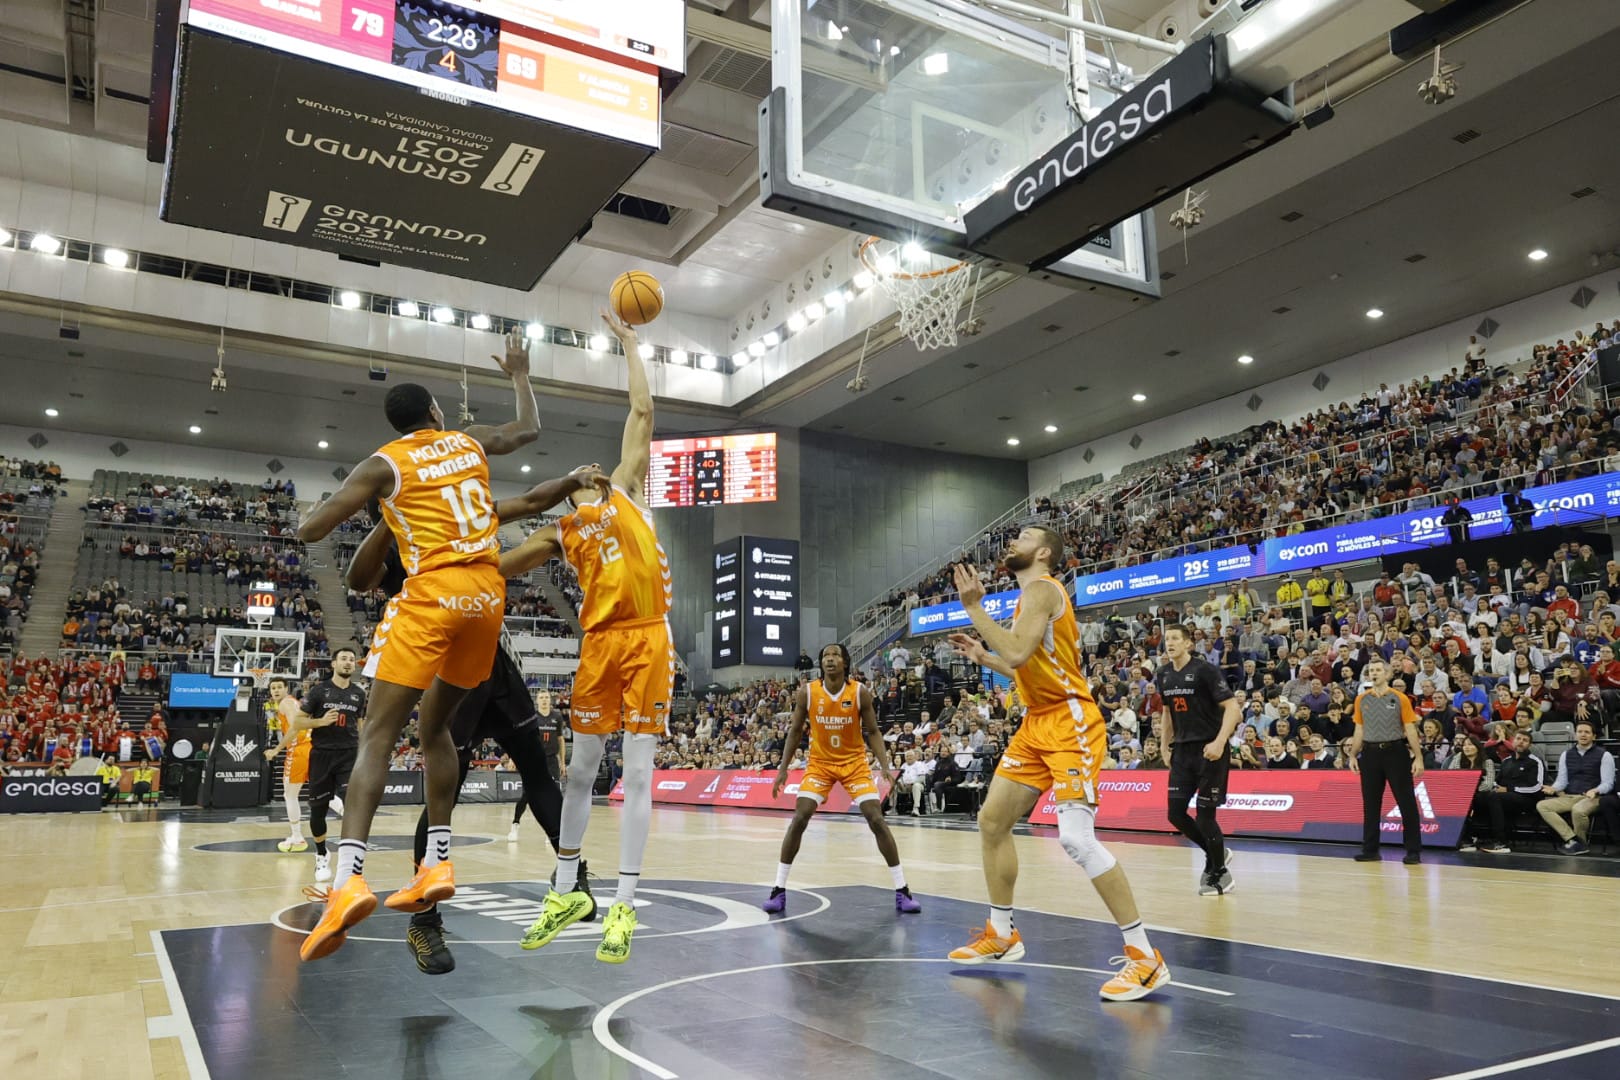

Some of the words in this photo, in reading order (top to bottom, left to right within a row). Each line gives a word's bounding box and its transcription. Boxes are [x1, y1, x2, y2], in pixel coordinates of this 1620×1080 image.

[351, 7, 385, 38] 79
[427, 18, 478, 50] 2:28
[439, 50, 457, 72] 4
[506, 53, 537, 80] 69
[296, 97, 352, 117] CULTURA
[354, 112, 369, 122] LA
[370, 117, 386, 127] DE
[385, 111, 450, 132] CANDIDATA
[389, 121, 443, 141] EUROPEA
[445, 134, 489, 151] CAPITAL
[452, 127, 494, 143] CIUDAD
[1013, 78, 1173, 212] endesa
[284, 128, 473, 185] GRANADA
[396, 137, 484, 168] 2031
[316, 217, 395, 241] 2031
[322, 204, 488, 246] GRANADA
[313, 228, 354, 243] CAPITAL
[429, 250, 470, 262] CULTURA
[407, 433, 471, 464] MOORE
[416, 451, 482, 482] PAMESA
[440, 478, 493, 538] 10
[599, 536, 624, 565] 12
[1279, 540, 1329, 561] excom
[1086, 578, 1124, 595] excom
[254, 593, 272, 607] 10
[438, 594, 485, 613] MGS
[815, 715, 853, 724] VALENCIA
[830, 735, 841, 748] 0
[5, 778, 101, 797] endesa
